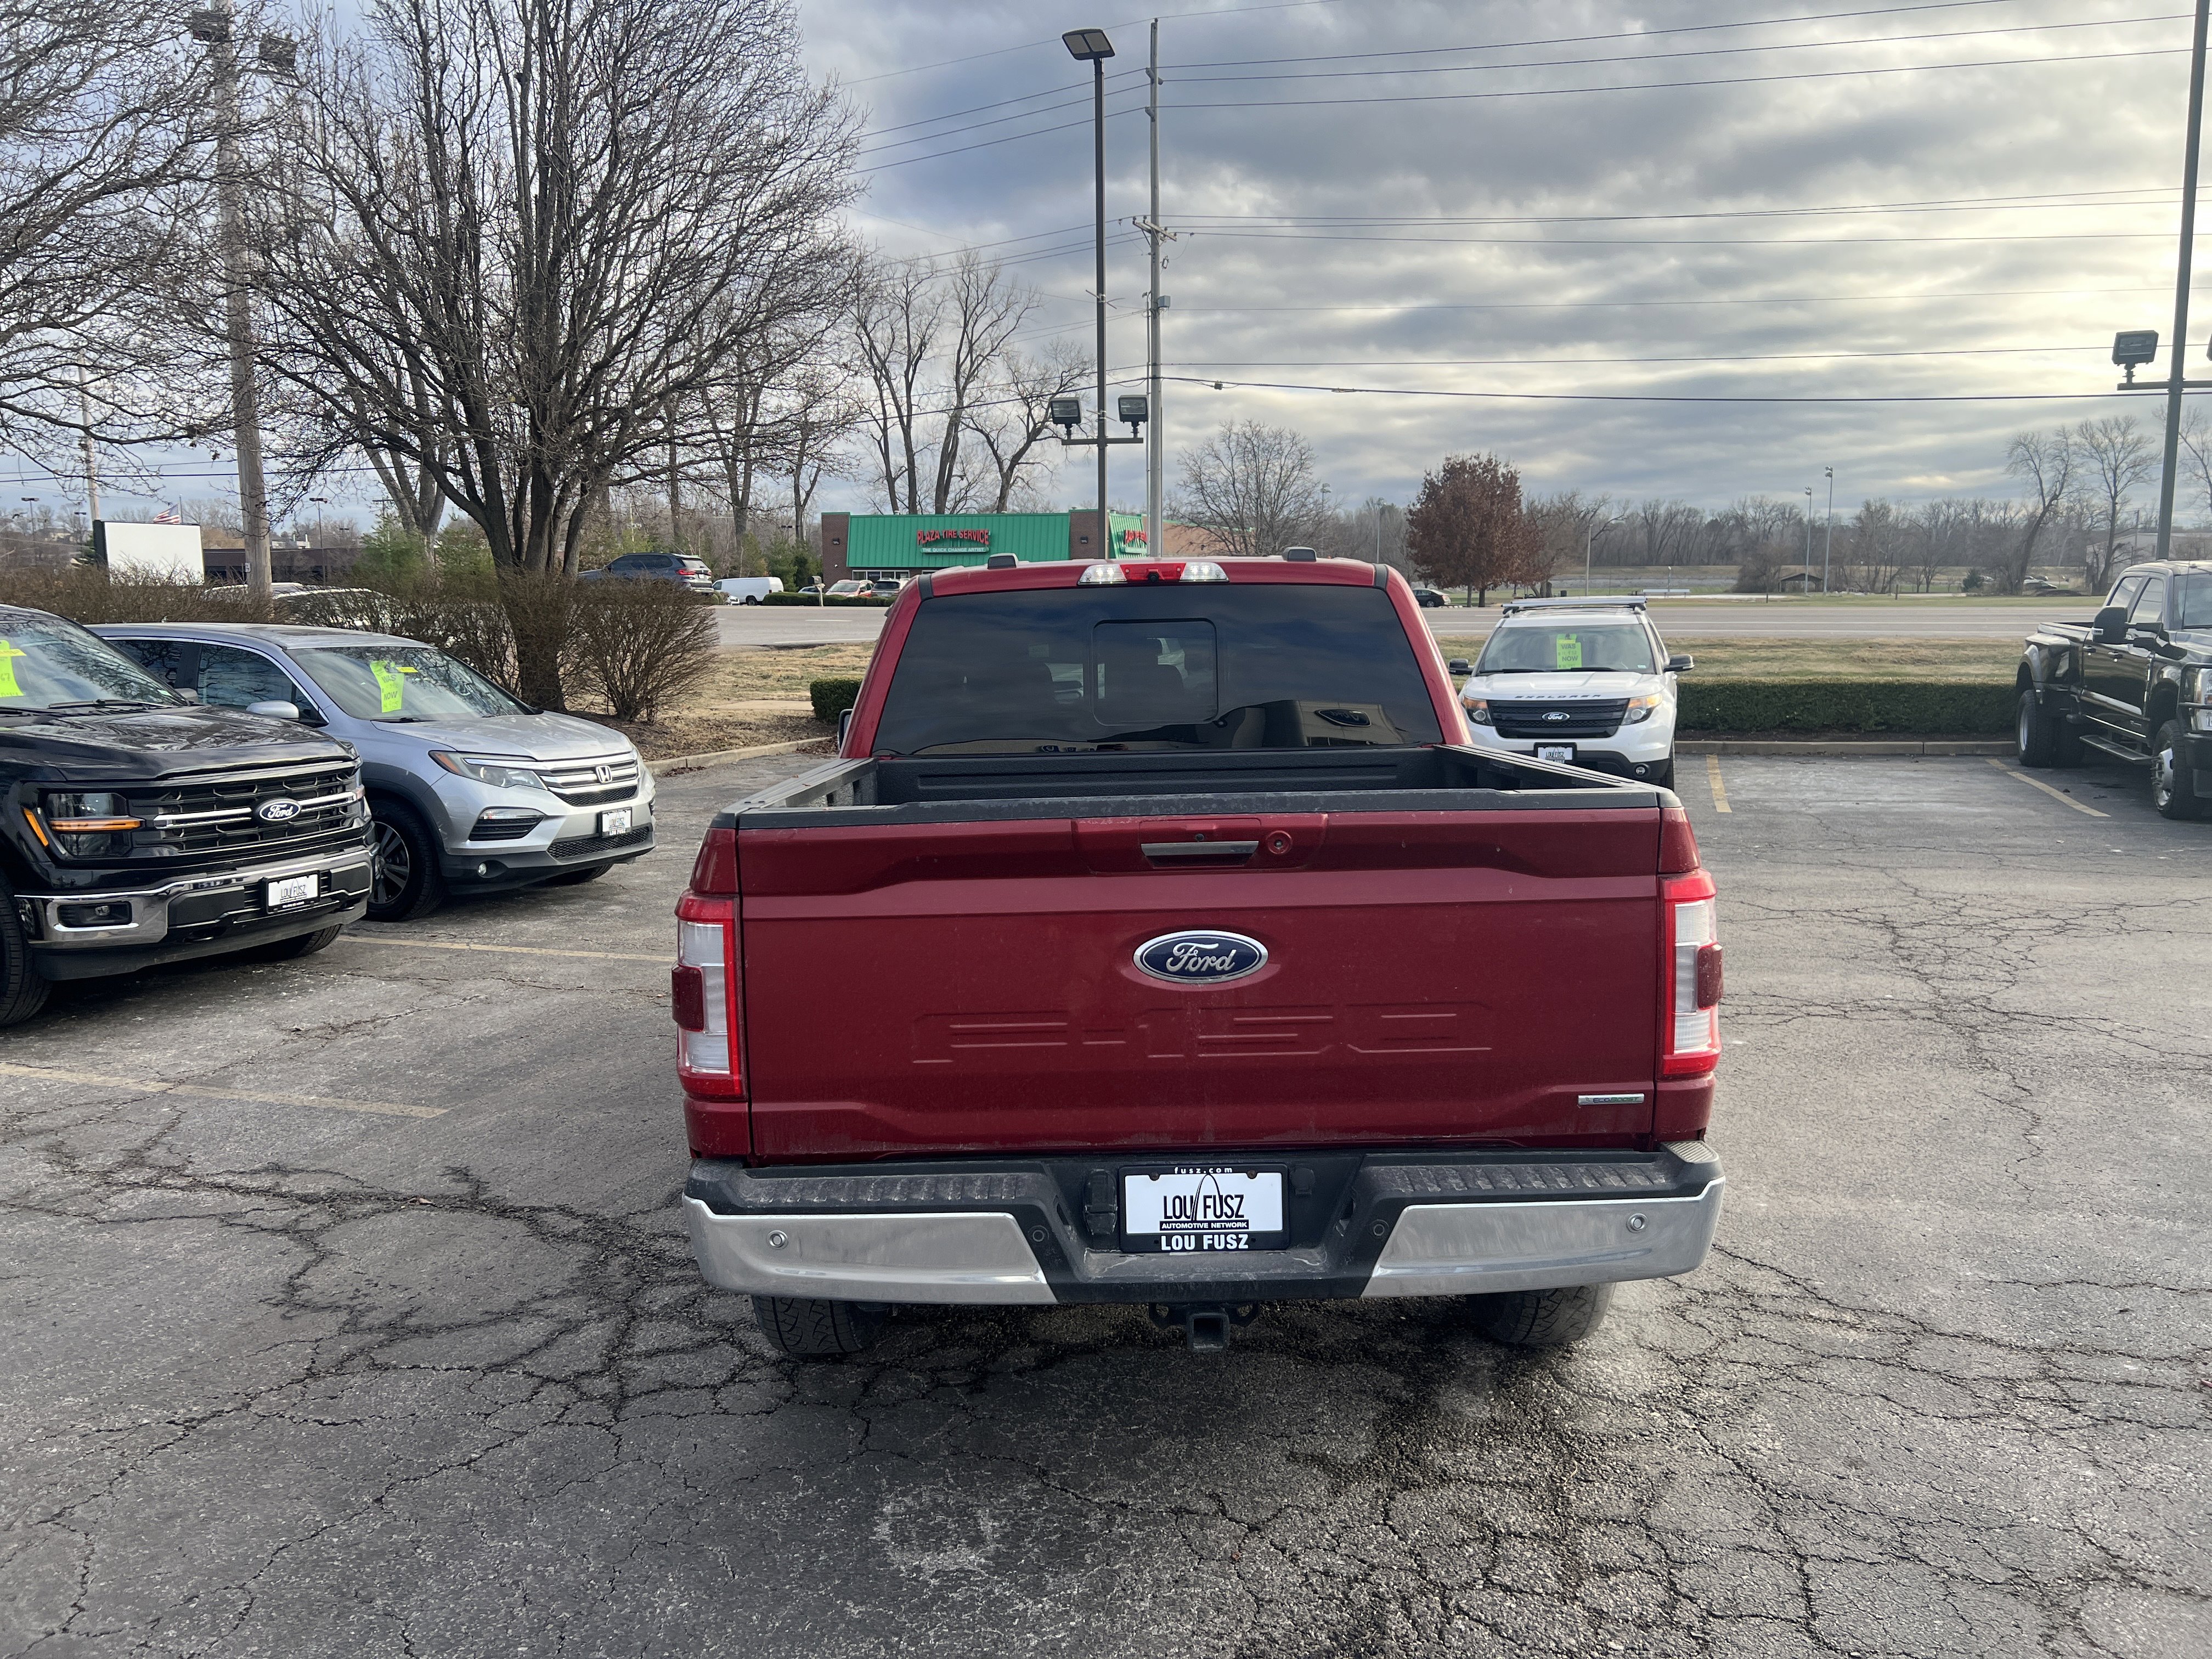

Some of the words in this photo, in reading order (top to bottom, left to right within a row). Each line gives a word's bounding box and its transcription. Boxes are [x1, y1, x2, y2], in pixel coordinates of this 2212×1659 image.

[917, 530, 940, 545] PLAZA
[943, 530, 957, 538] TIRE
[959, 529, 989, 544] SERVICE
[381, 675, 396, 683] WAS
[384, 691, 398, 700] NOW
[268, 804, 293, 818] Ford
[281, 888, 291, 898] LOU
[294, 885, 306, 895] FUSZ
[1166, 942, 1237, 972] Ford
[912, 1002, 1493, 1063] F-150
[1164, 1195, 1194, 1219] LOU
[1203, 1194, 1244, 1218] FUSZ
[1161, 1235, 1196, 1250] LOU
[1203, 1234, 1248, 1250] FUSZ
